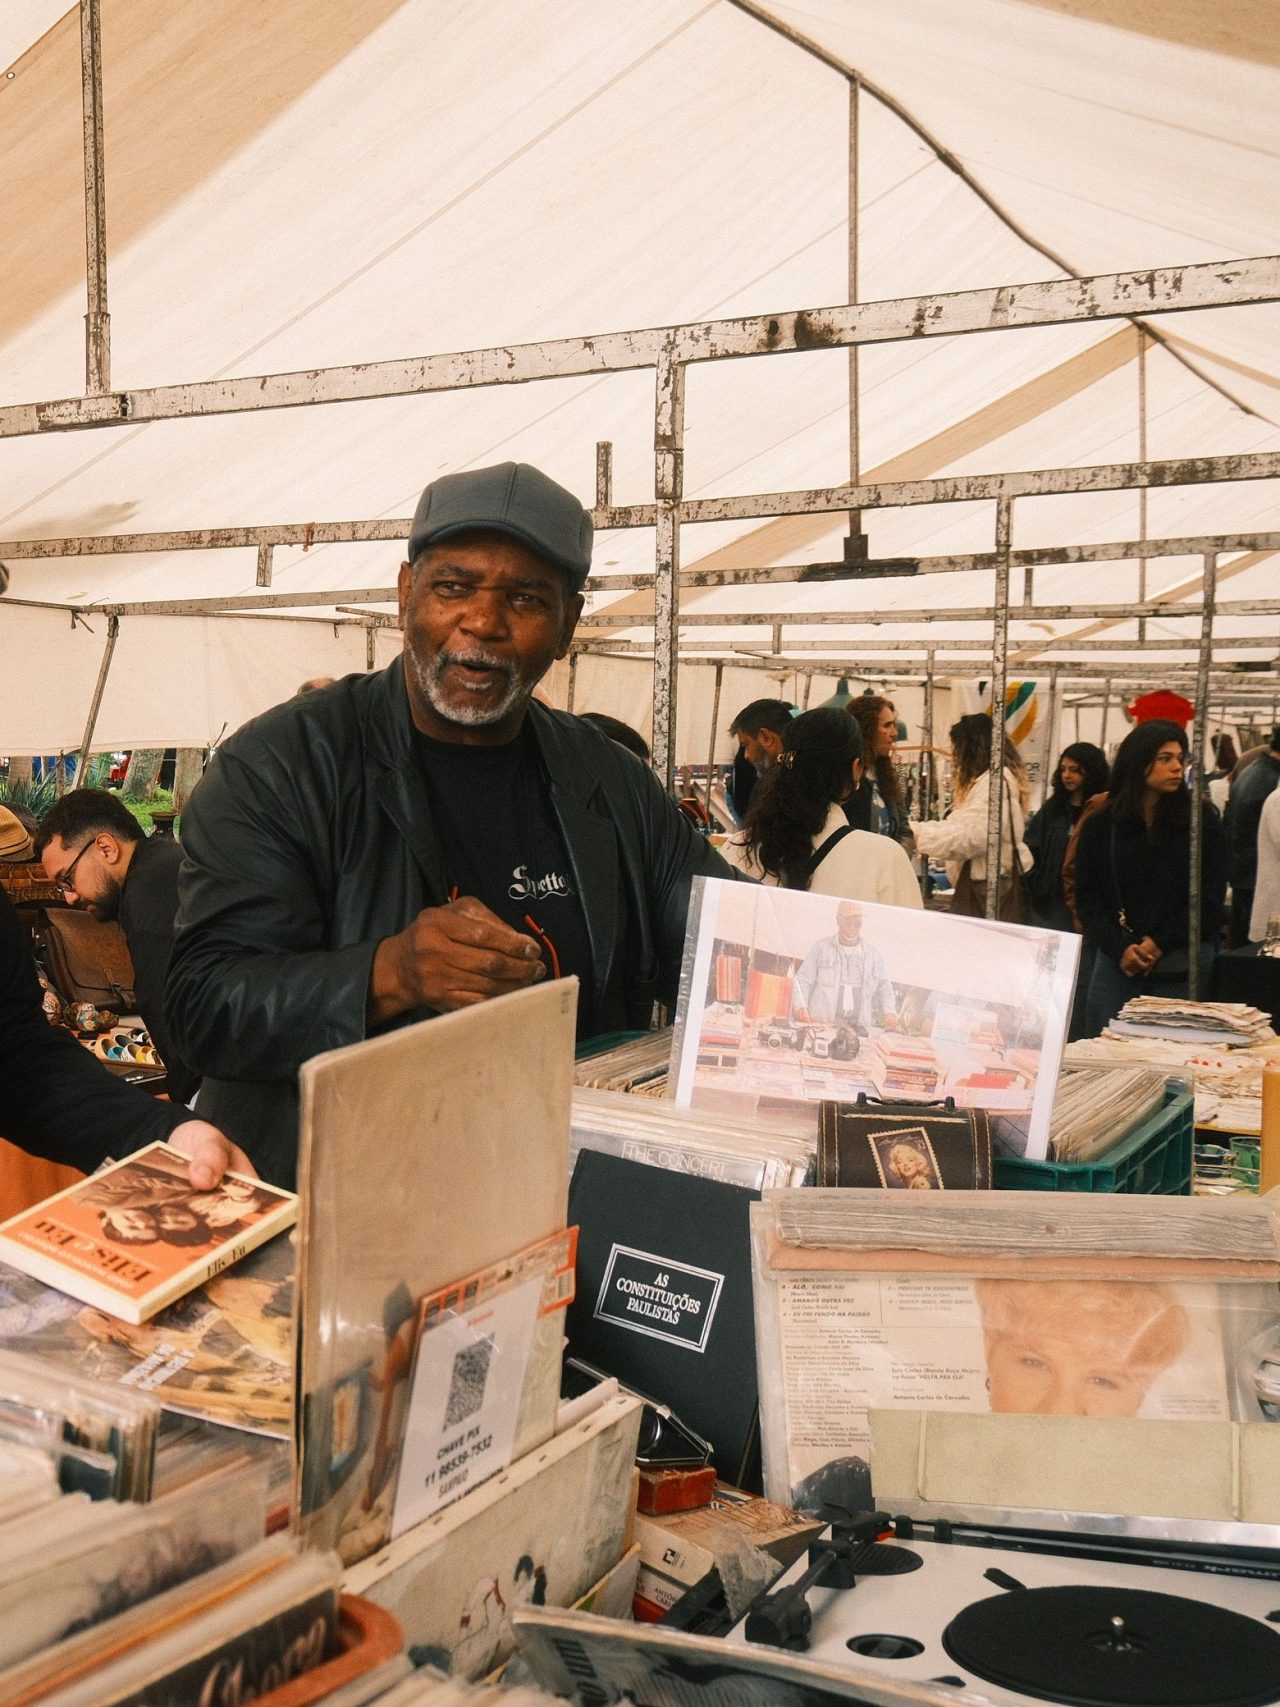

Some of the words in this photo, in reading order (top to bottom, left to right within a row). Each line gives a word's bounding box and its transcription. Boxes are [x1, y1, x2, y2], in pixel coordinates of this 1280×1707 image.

[628, 1144, 655, 1162] THE
[658, 1150, 728, 1177] CONCERT
[92, 1247, 152, 1283] Elis
[653, 1272, 669, 1287] AS
[616, 1277, 701, 1314] CONSTITUIÇÕES
[626, 1297, 680, 1325] PAULISTAS
[437, 1433, 466, 1460] CHAVE
[467, 1425, 481, 1441] PIX
[424, 1469, 436, 1488] 11
